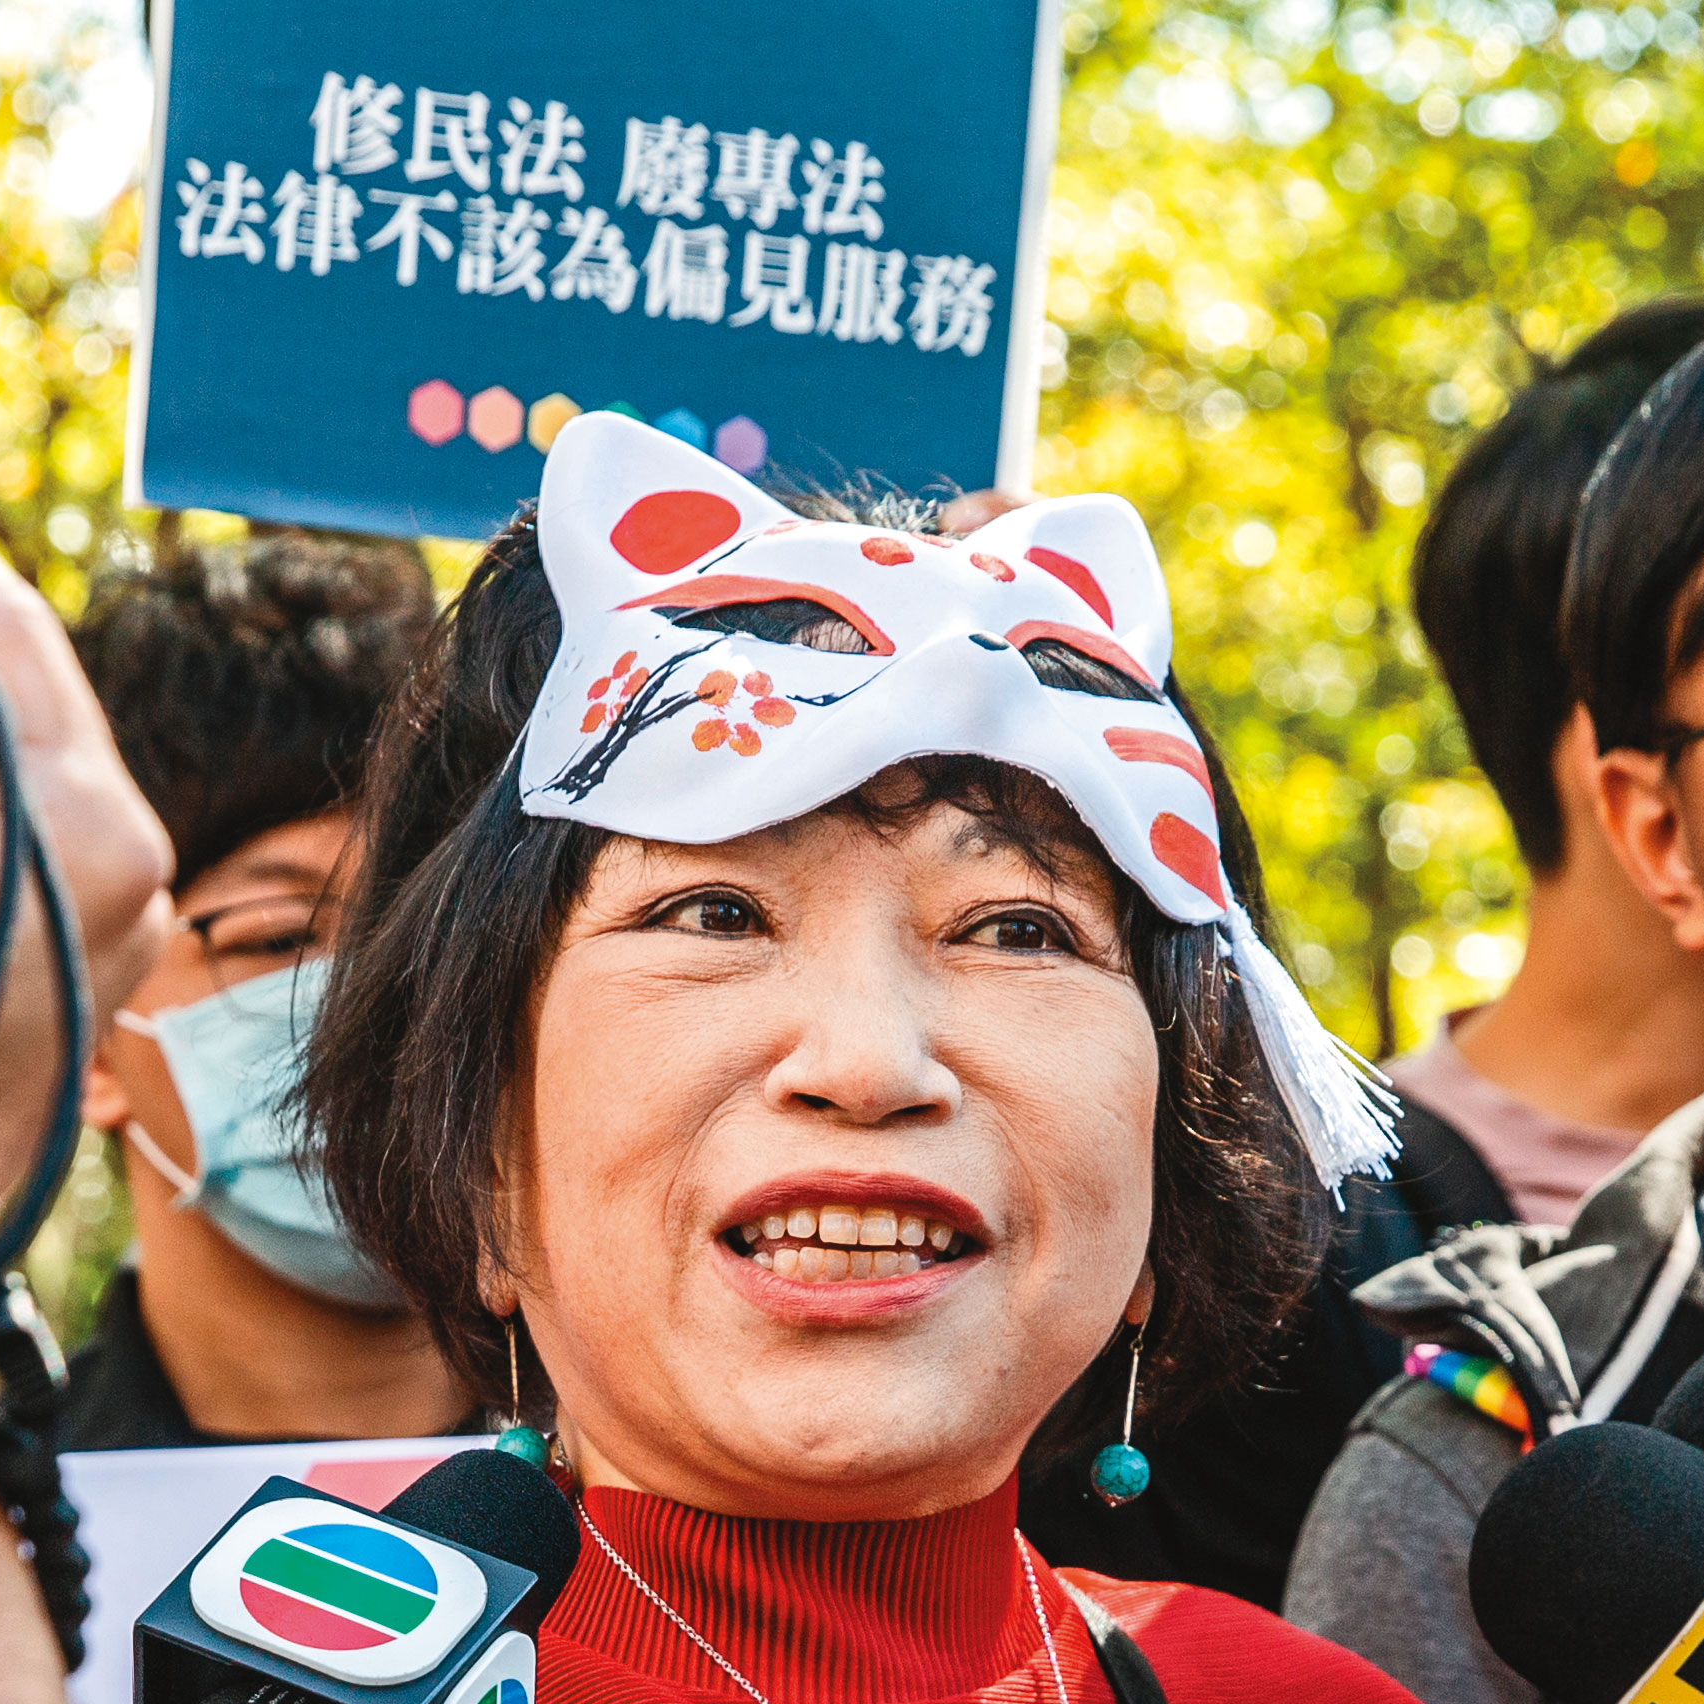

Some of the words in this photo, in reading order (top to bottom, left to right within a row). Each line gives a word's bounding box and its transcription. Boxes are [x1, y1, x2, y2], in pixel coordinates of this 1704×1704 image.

[309, 72, 587, 202] 修民法
[616, 115, 887, 242] 廢專法
[176, 158, 998, 358] 法律不該為偏見服務
